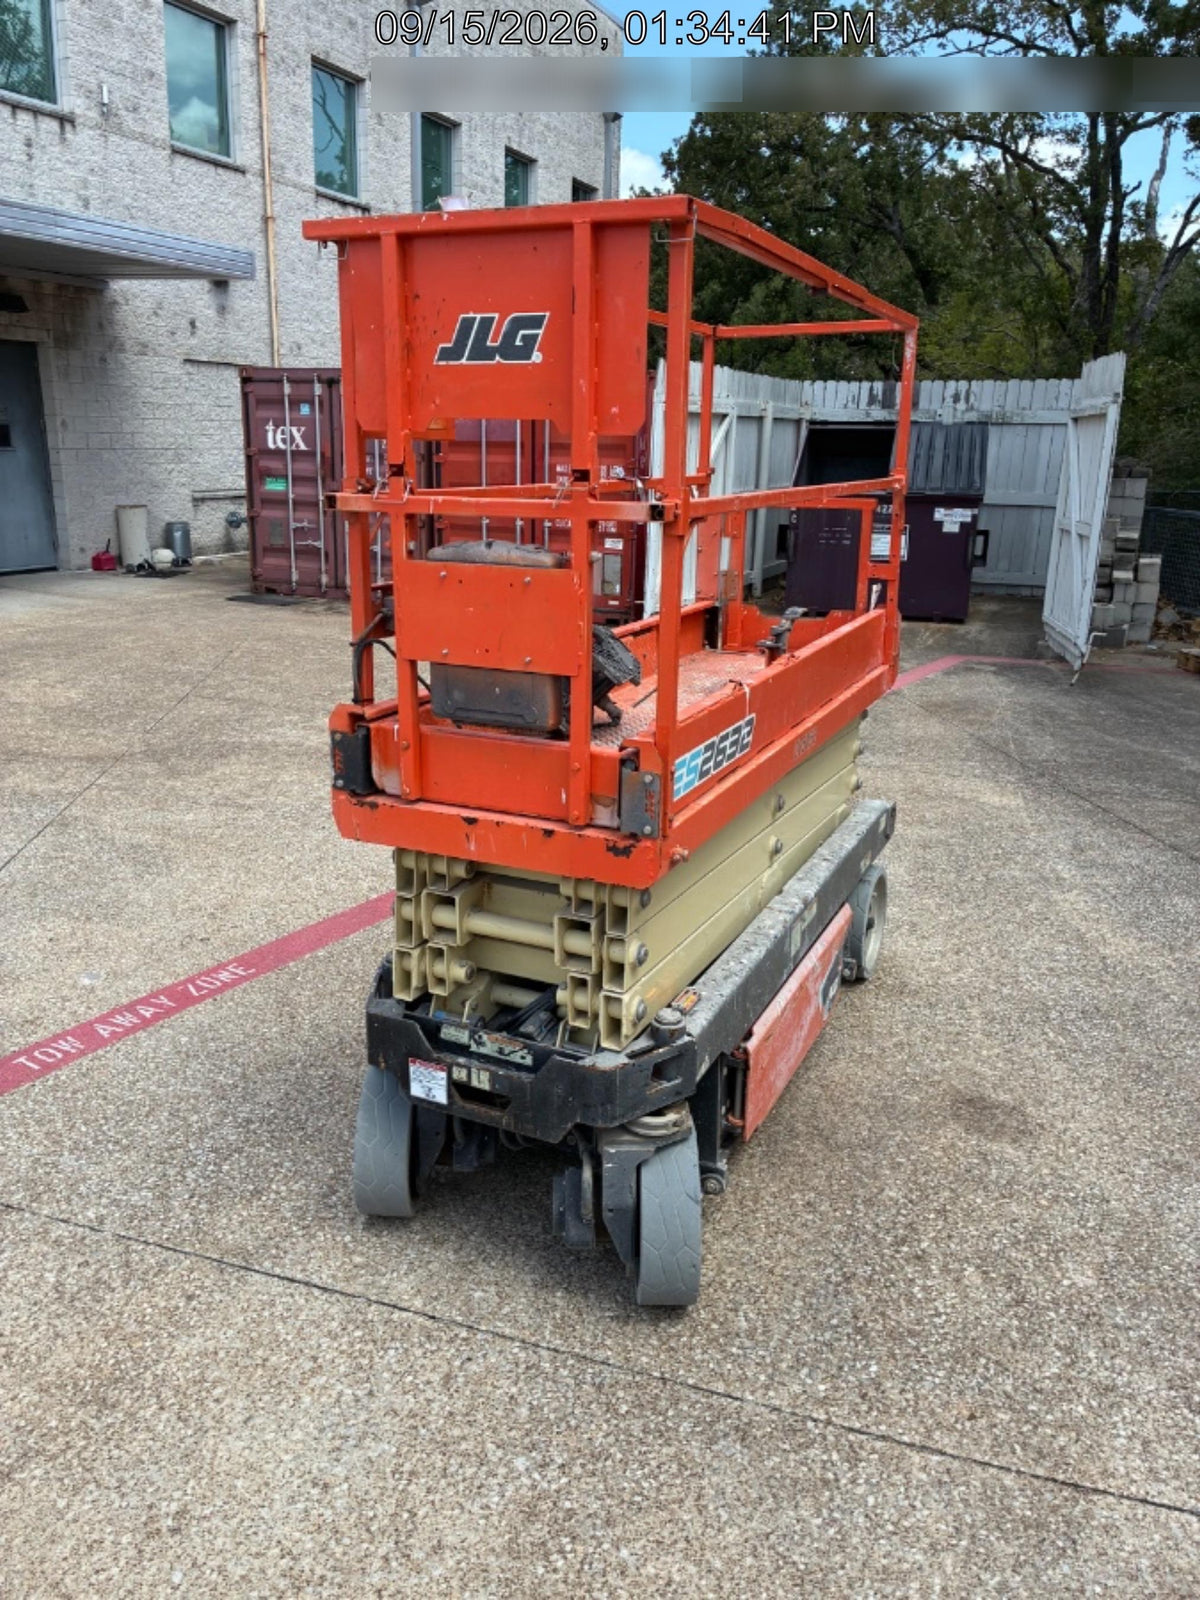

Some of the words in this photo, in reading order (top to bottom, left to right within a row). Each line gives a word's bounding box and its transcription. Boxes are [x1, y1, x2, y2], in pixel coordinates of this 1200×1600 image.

[433, 311, 549, 365] JLG
[264, 418, 312, 450] tex
[673, 713, 756, 802] ES2632
[11, 1036, 85, 1070] TOW
[93, 995, 177, 1038] AWAY
[177, 962, 256, 997] ZONE
